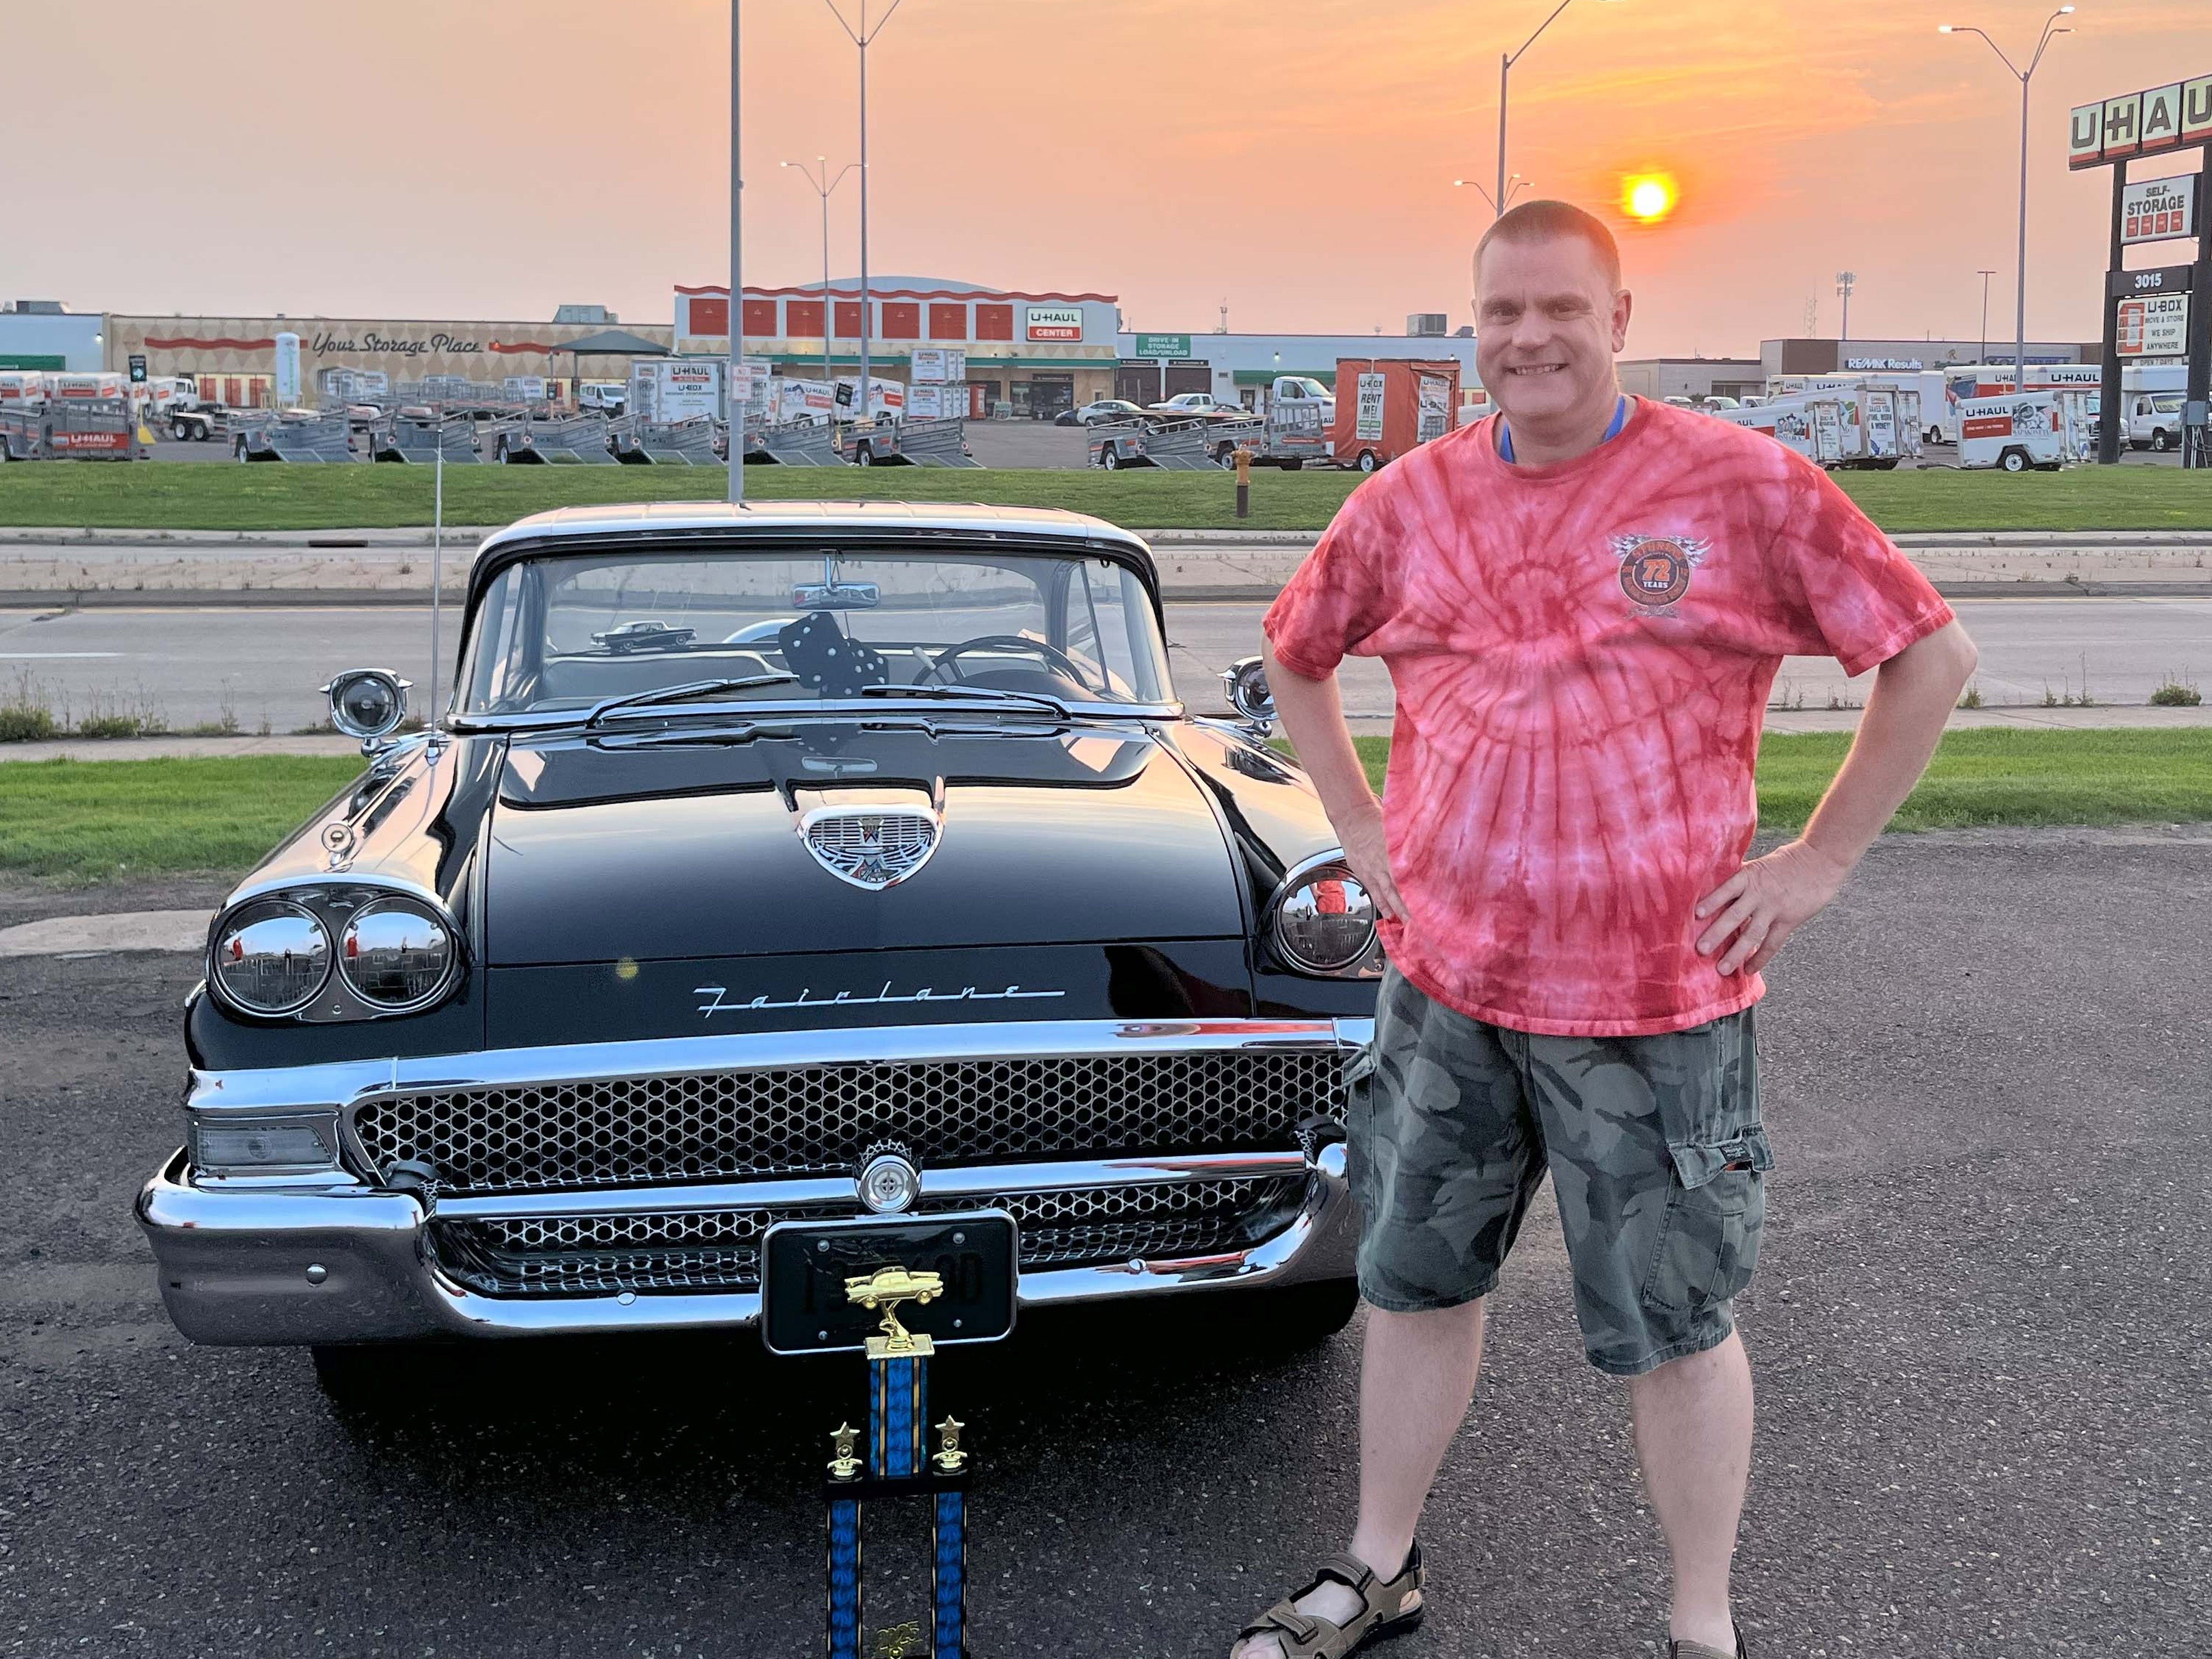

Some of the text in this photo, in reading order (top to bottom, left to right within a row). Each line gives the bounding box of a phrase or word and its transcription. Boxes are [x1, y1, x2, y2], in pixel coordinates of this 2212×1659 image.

[2072, 84, 2212, 149] U-HAU
[2146, 185, 2171, 198] SELF-
[2128, 195, 2185, 216] STORAGE
[2134, 273, 2162, 289] 3015
[2148, 299, 2182, 313] U-BOX
[1031, 313, 1077, 321] U-HAUL
[1036, 329, 1074, 337] CENTER
[312, 332, 484, 357] Your Storage Place
[1848, 358, 1923, 369] RE/MAX Results
[2051, 374, 2099, 382] U-HAUL
[1361, 393, 1382, 404] RENT
[1966, 407, 2008, 417] U-HAUL
[1643, 558, 1671, 581] 72
[693, 980, 1065, 1019] Fairlane
